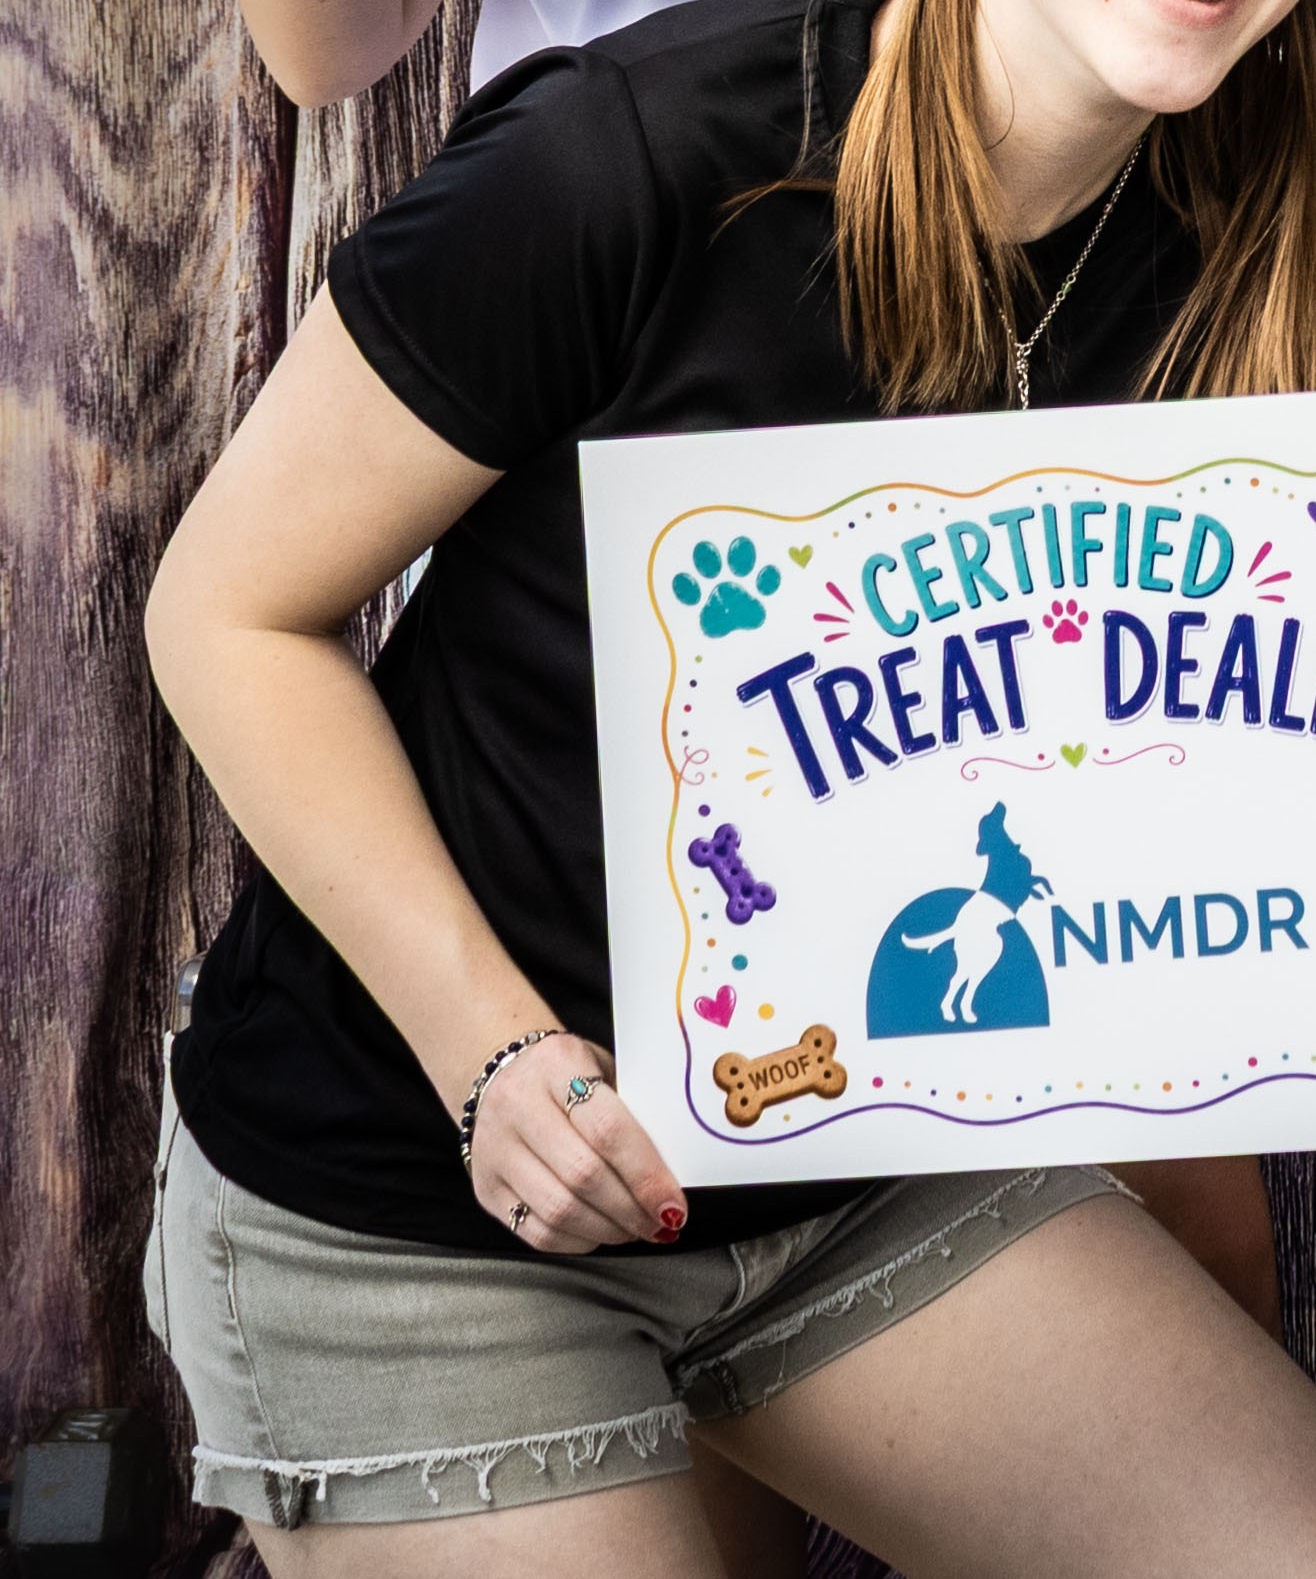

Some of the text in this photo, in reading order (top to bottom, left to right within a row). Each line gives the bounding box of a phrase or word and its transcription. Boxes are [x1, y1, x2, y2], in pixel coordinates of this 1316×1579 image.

[862, 501, 1235, 637] CERTIFIED
[737, 619, 1029, 799] TREAT
[1051, 887, 1309, 968] NMDR
[748, 1054, 811, 1091] WOOF
